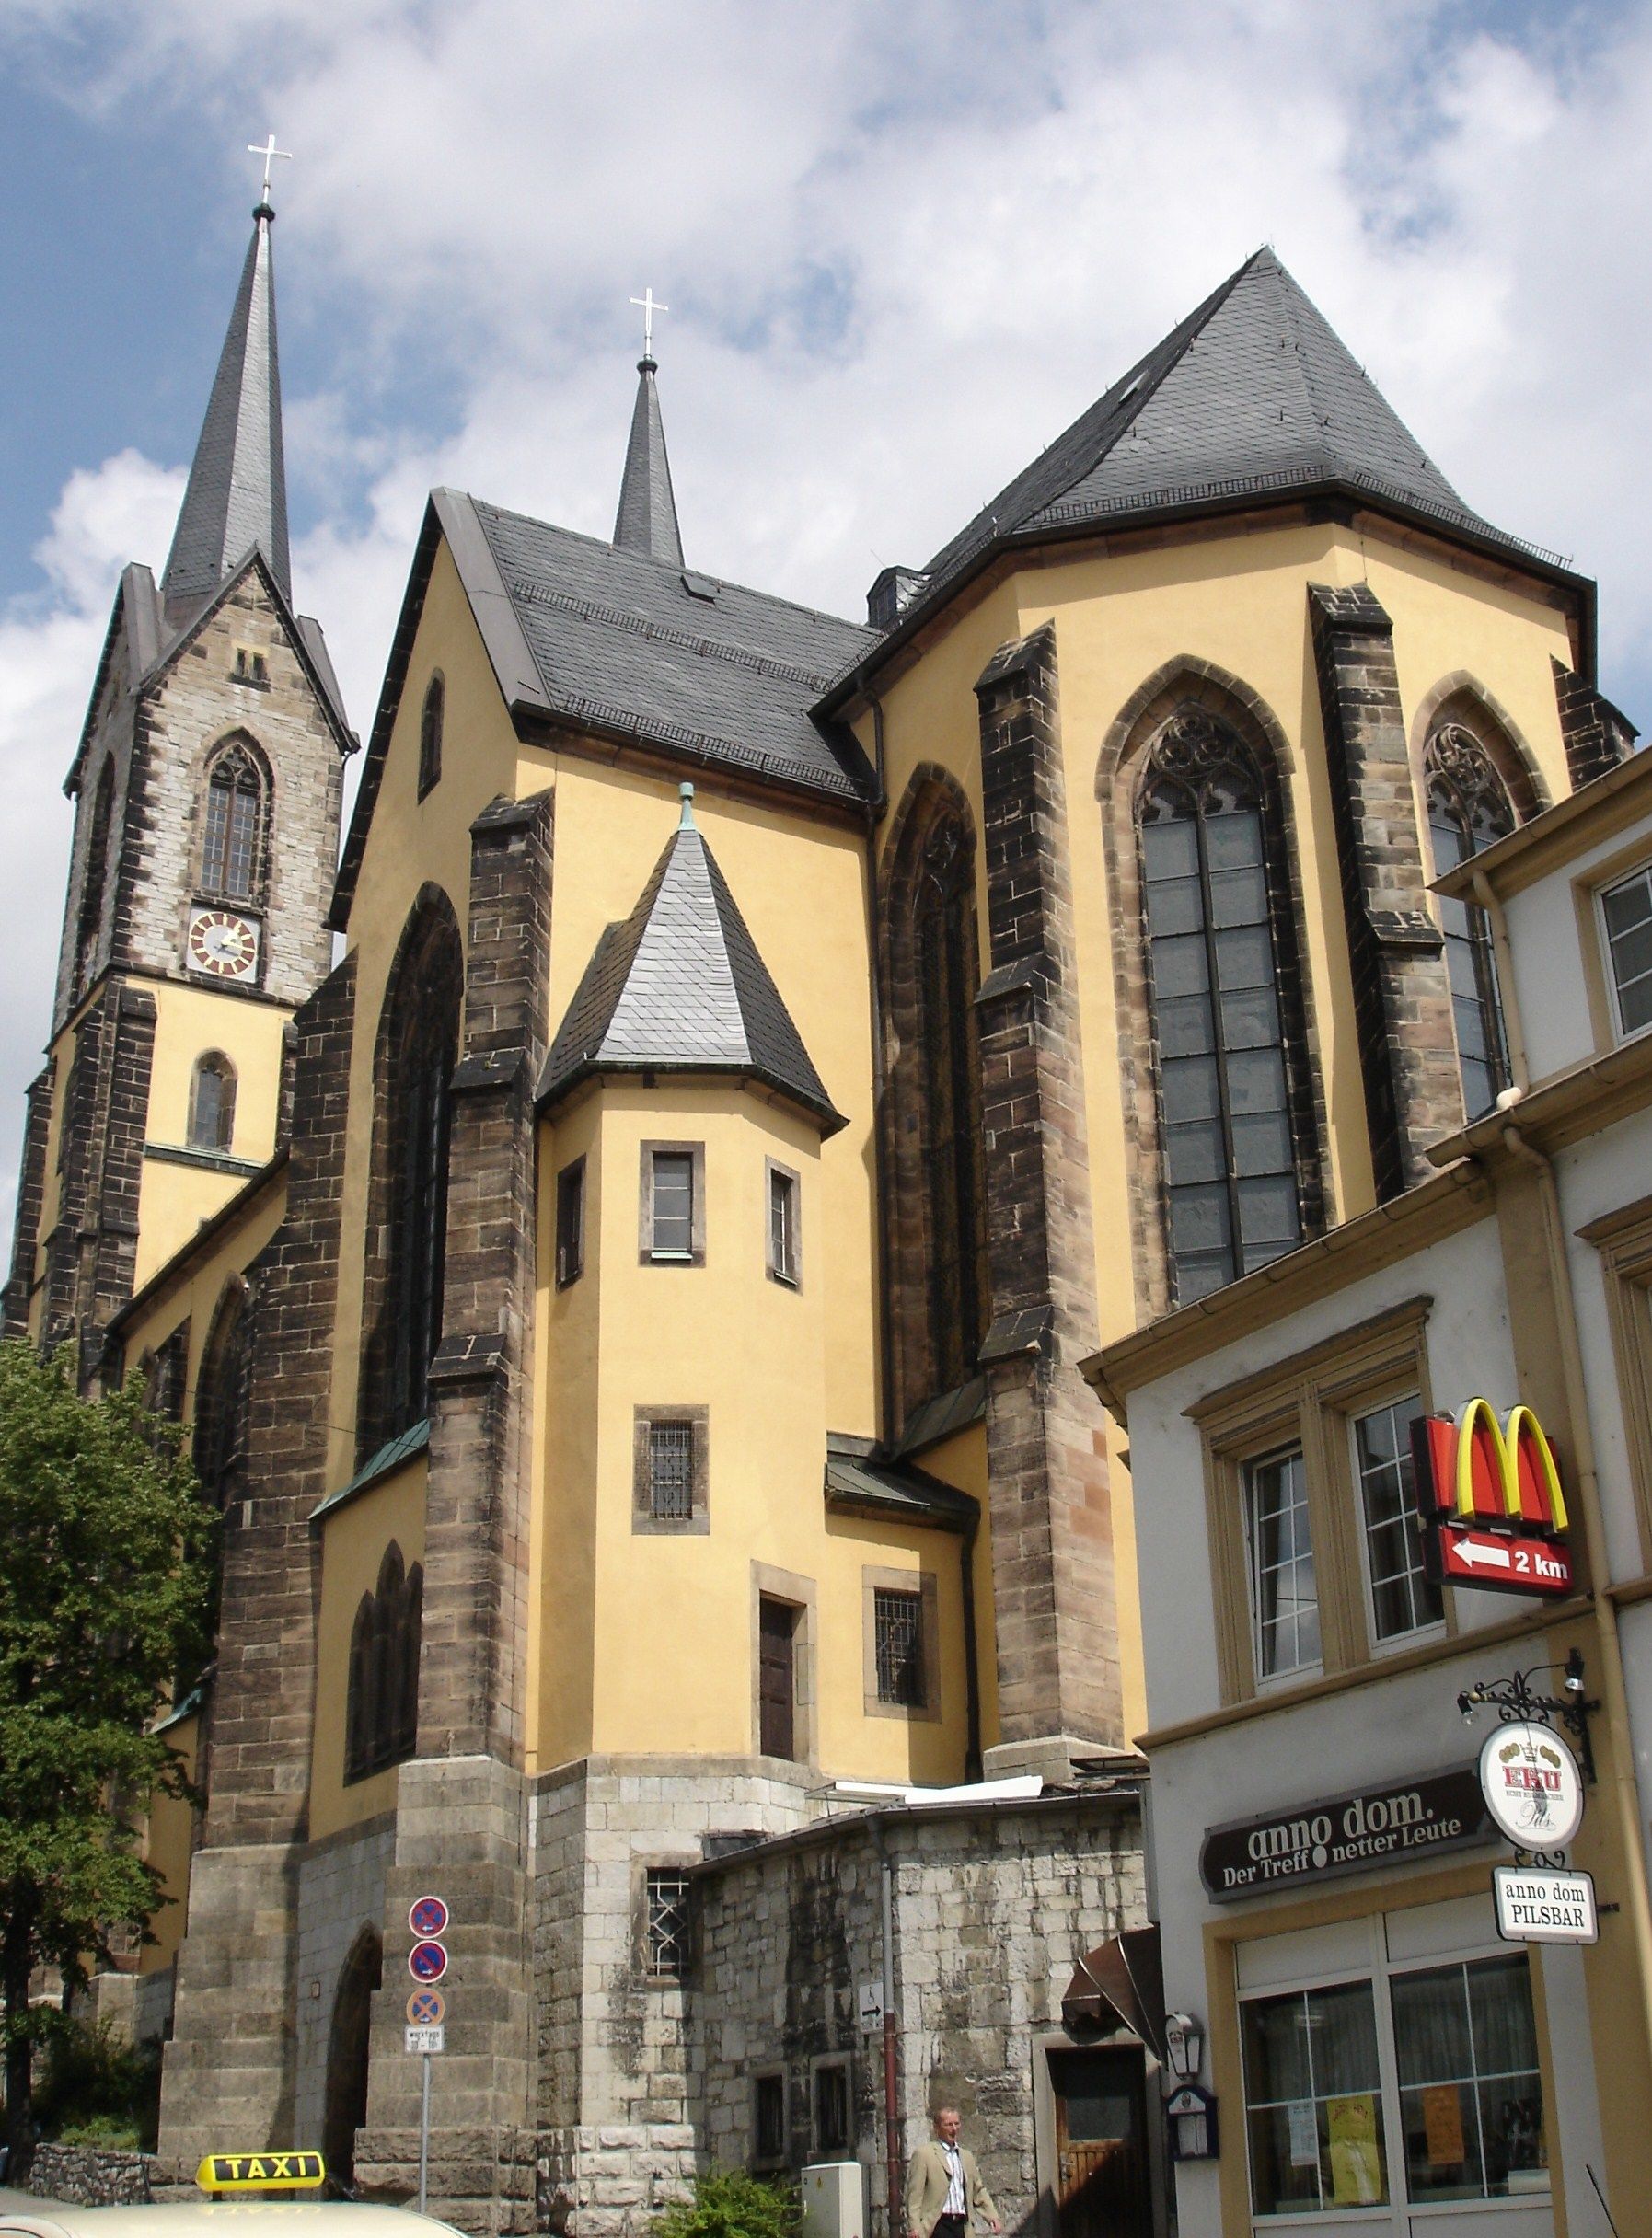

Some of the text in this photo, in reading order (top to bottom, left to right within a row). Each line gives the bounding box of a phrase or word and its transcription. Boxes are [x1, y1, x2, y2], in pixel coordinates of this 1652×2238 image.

[1457, 1398, 1568, 1534] M
[1514, 1551, 1568, 1579] 2 km
[1502, 1765, 1562, 1792] EKU
[1248, 1793, 1434, 1860] anno dom.
[1516, 1800, 1557, 1831] Pils
[1222, 1817, 1461, 1887] Der Treff netter Leute
[1506, 1882, 1585, 1902] anno dom
[1511, 1904, 1585, 1927] PILSBAR
[225, 2156, 306, 2179] TAXI
